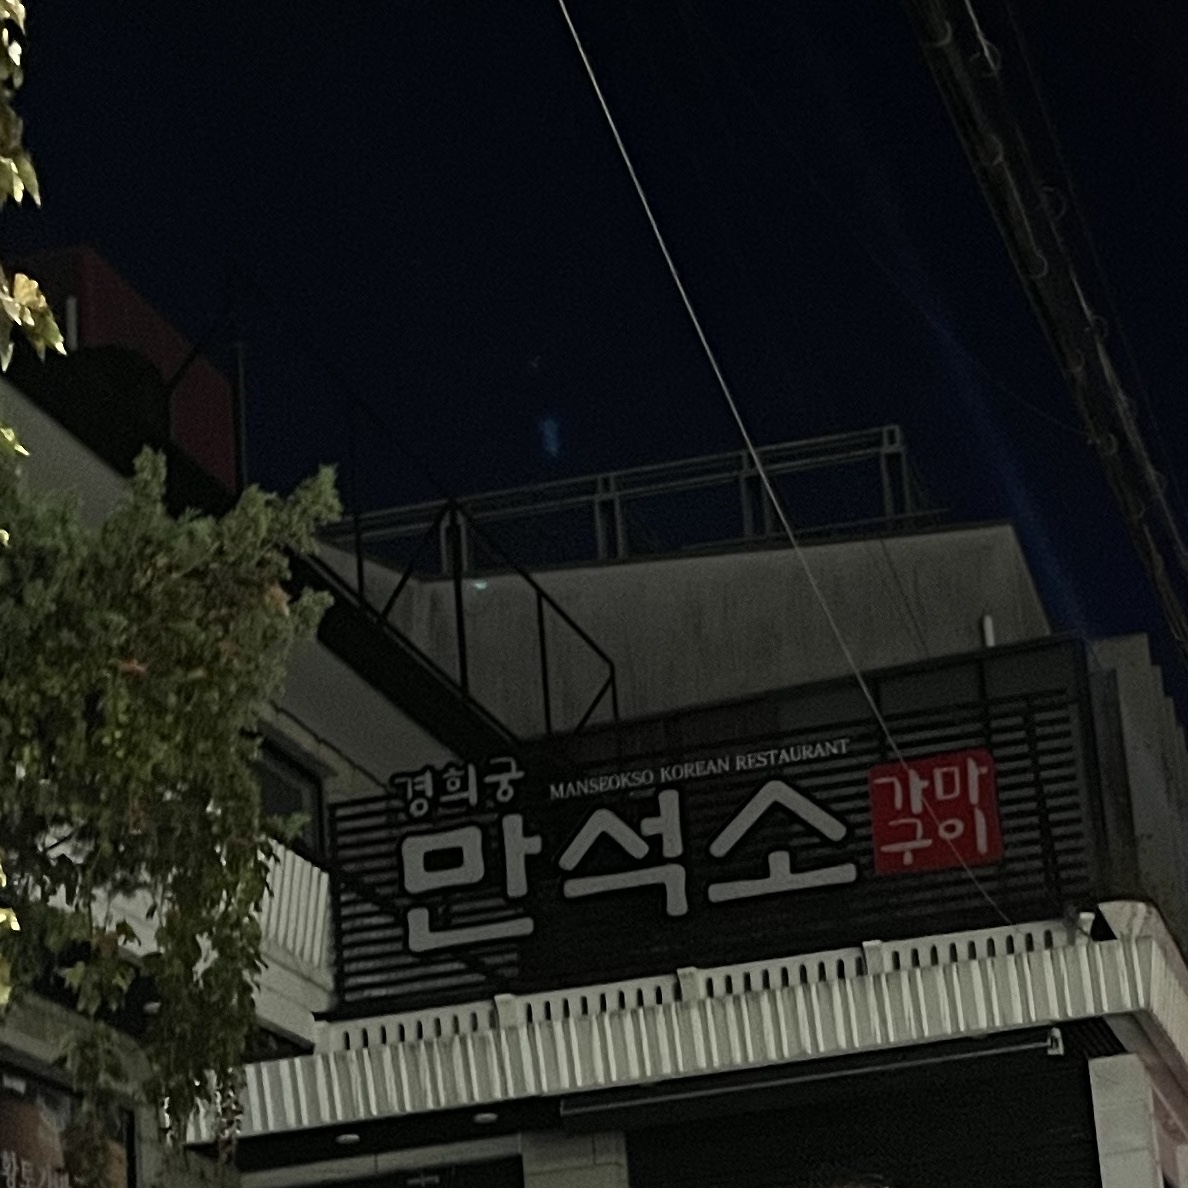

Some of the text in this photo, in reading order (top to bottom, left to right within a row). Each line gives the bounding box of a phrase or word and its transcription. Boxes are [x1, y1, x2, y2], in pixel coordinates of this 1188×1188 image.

[392, 756, 526, 818] 경희궁
[550, 738, 850, 800] MANSEOKSO KOREAN RESTAURANT
[873, 756, 988, 815] 가마
[401, 780, 857, 953] 만석소
[880, 807, 988, 865] 구이
